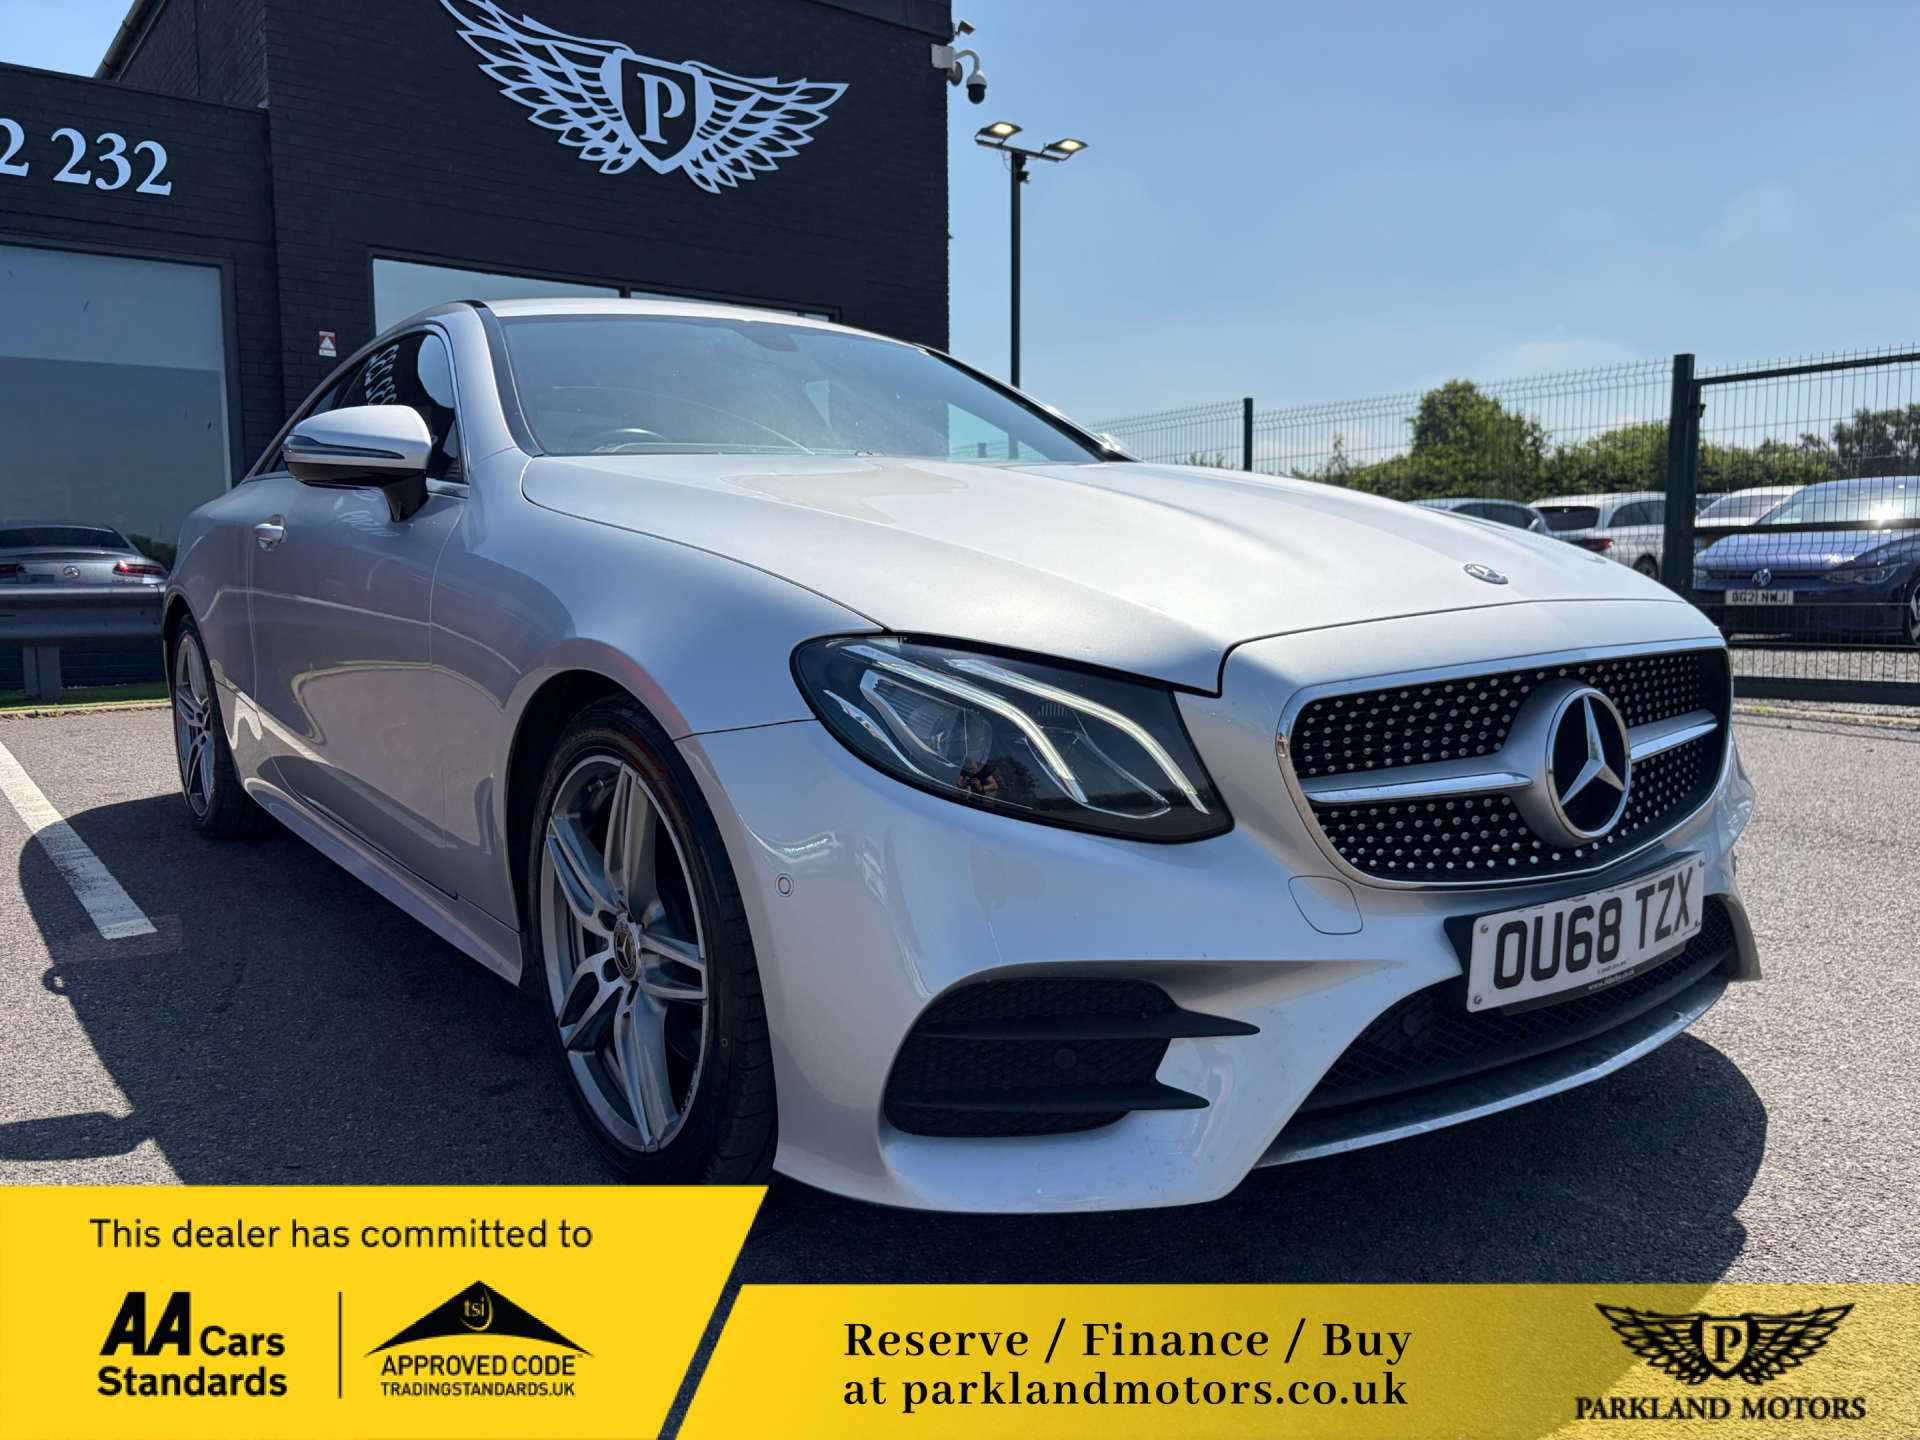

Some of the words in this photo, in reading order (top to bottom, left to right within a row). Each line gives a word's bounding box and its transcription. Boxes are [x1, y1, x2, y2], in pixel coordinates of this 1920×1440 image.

[636, 72, 686, 145] P
[0, 118, 29, 177] 2
[51, 128, 173, 196] 232
[1493, 896, 1623, 990] OU68
[1635, 866, 1693, 950] TZX
